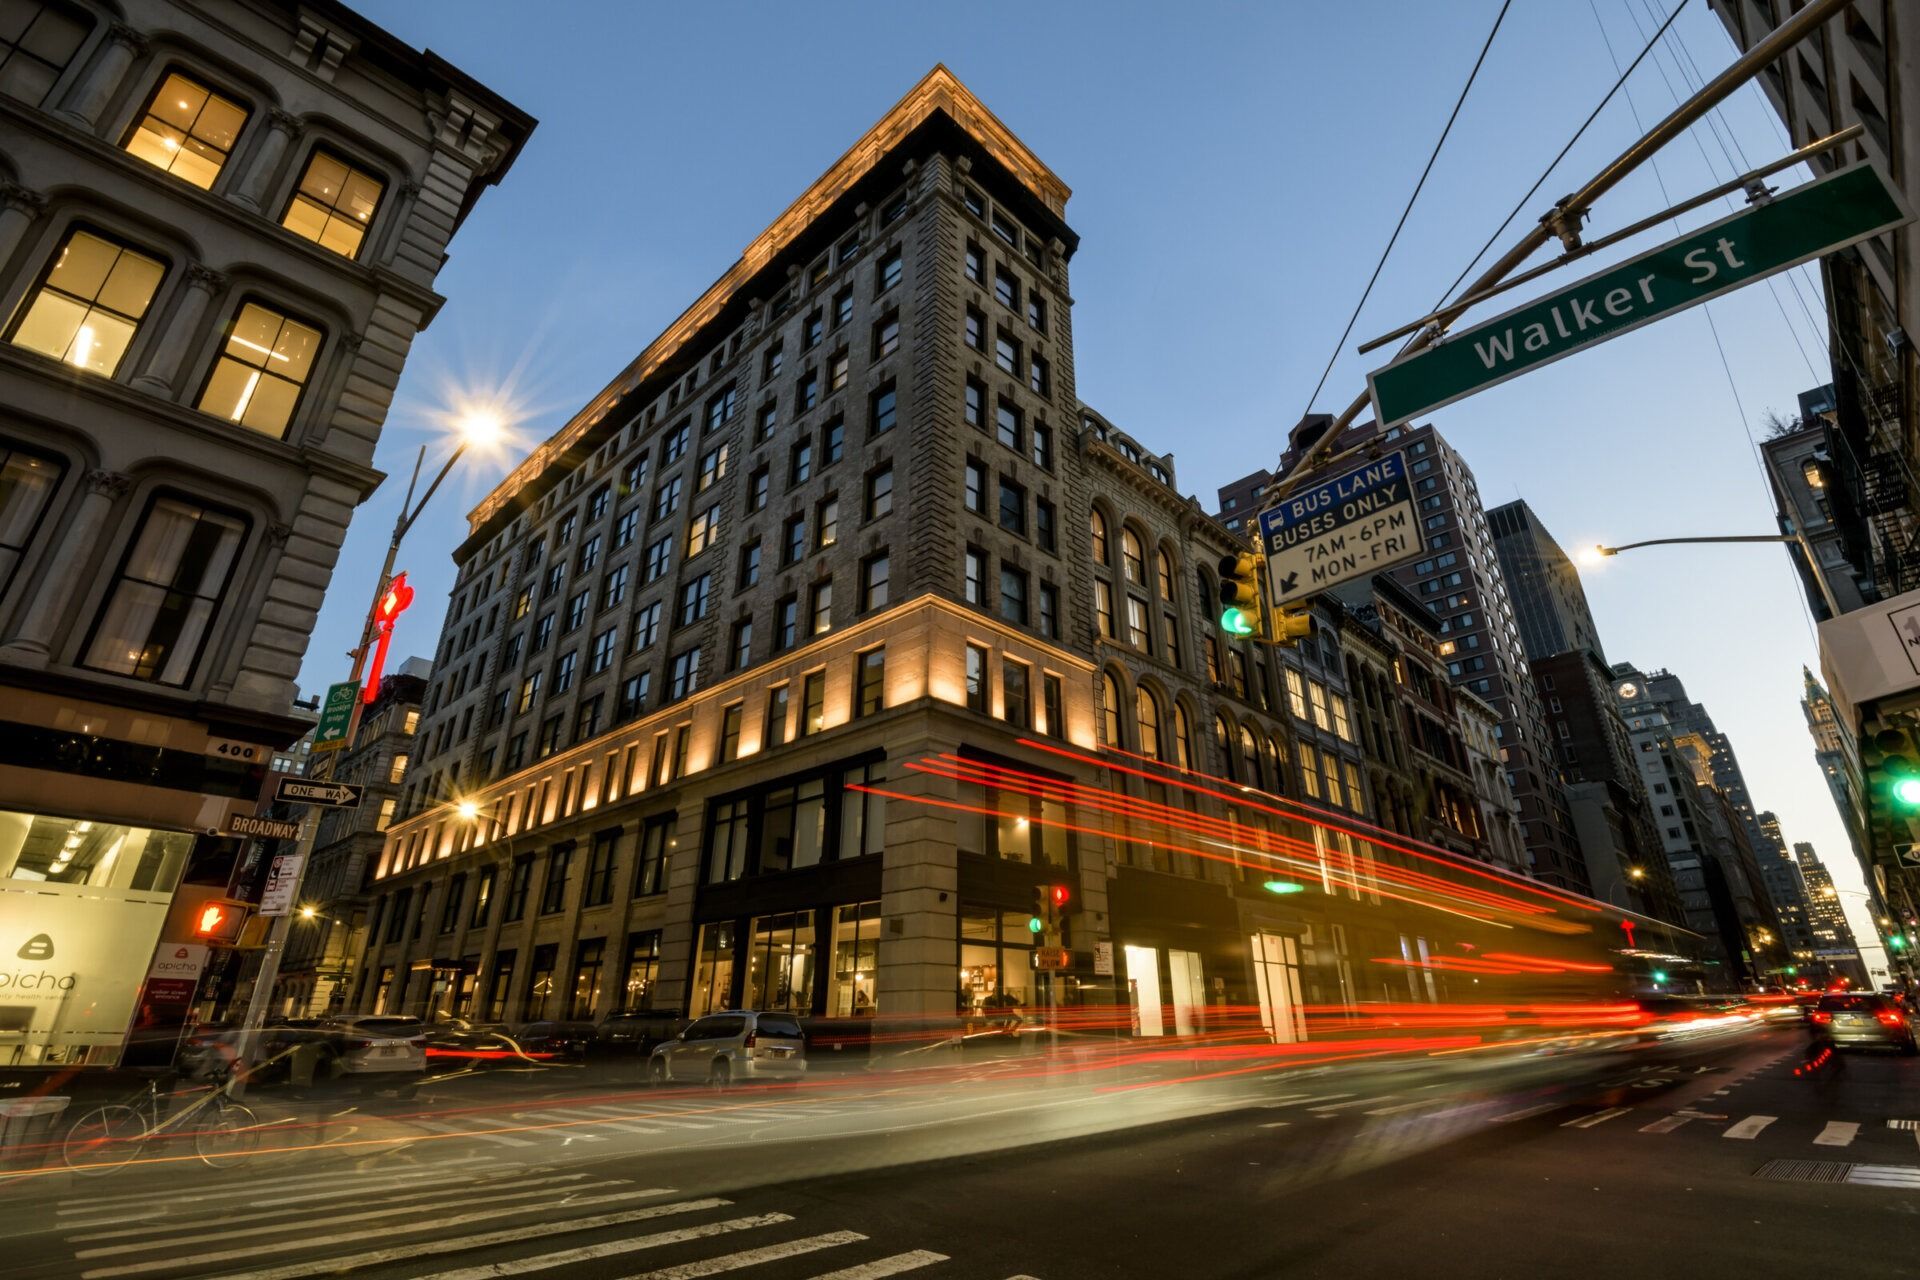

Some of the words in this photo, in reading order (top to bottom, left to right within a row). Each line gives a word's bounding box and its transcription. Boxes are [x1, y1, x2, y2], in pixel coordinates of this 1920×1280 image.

[1474, 273, 1656, 369] Walker
[1683, 237, 1745, 284] St
[1292, 489, 1332, 518] BUS
[1337, 460, 1396, 498] LANE
[1271, 512, 1336, 551] BUSES
[1343, 483, 1397, 520] ONLY
[1304, 510, 1406, 563] 7AM-6PM
[1311, 534, 1406, 583] MON-FRI
[218, 743, 253, 758] 400
[291, 785, 315, 797] ONE
[325, 788, 350, 800] WAY
[231, 816, 296, 838] BROADWAY
